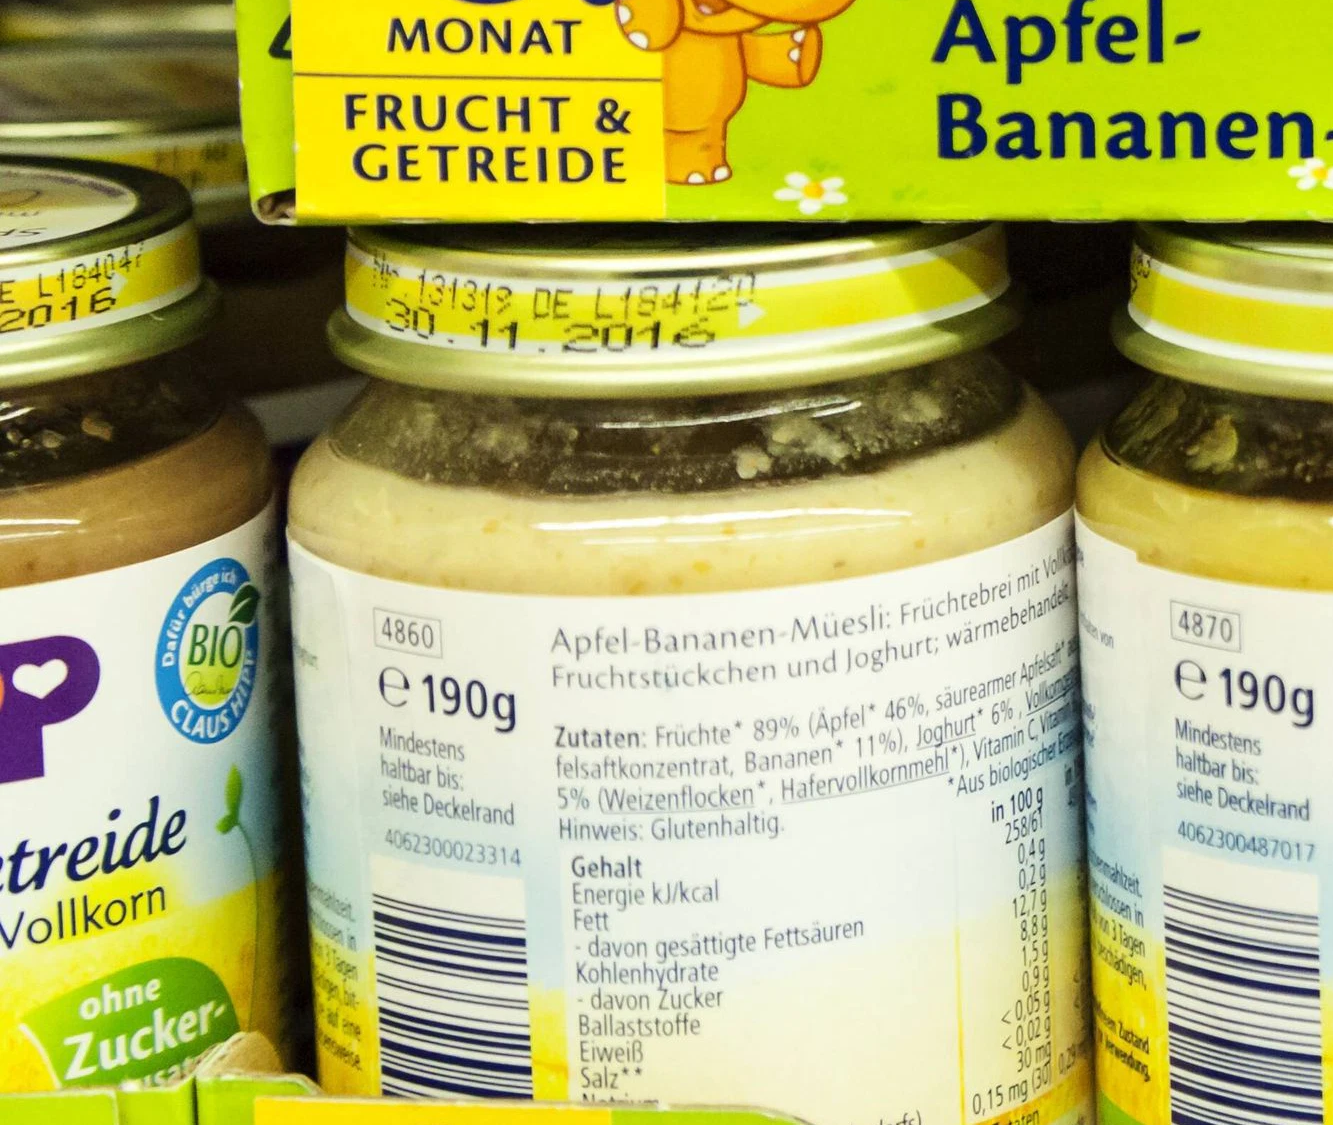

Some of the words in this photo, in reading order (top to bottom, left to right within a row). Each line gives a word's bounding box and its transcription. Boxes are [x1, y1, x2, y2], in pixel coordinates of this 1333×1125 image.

[386, 16, 582, 56] MONAT
[344, 92, 570, 136] FRUCHT
[598, 98, 631, 136] &
[352, 142, 628, 185] GETREIDE
[532, 287, 573, 319] DE
[384, 297, 716, 355] 30.11.2016
[187, 623, 243, 671] BIO
[382, 616, 434, 650] 4860
[550, 602, 892, 661] Apfel-Bananen-Müesli:
[1177, 609, 1234, 644] 4870
[422, 673, 517, 734] 190g
[1218, 666, 1315, 730] 190g
[423, 791, 515, 826] Deckelrand
[1177, 819, 1316, 864] 4062300487017
[0, 884, 166, 950] Vollkorn
[79, 977, 162, 1021] ohne
[62, 999, 227, 1081] Zucker-
